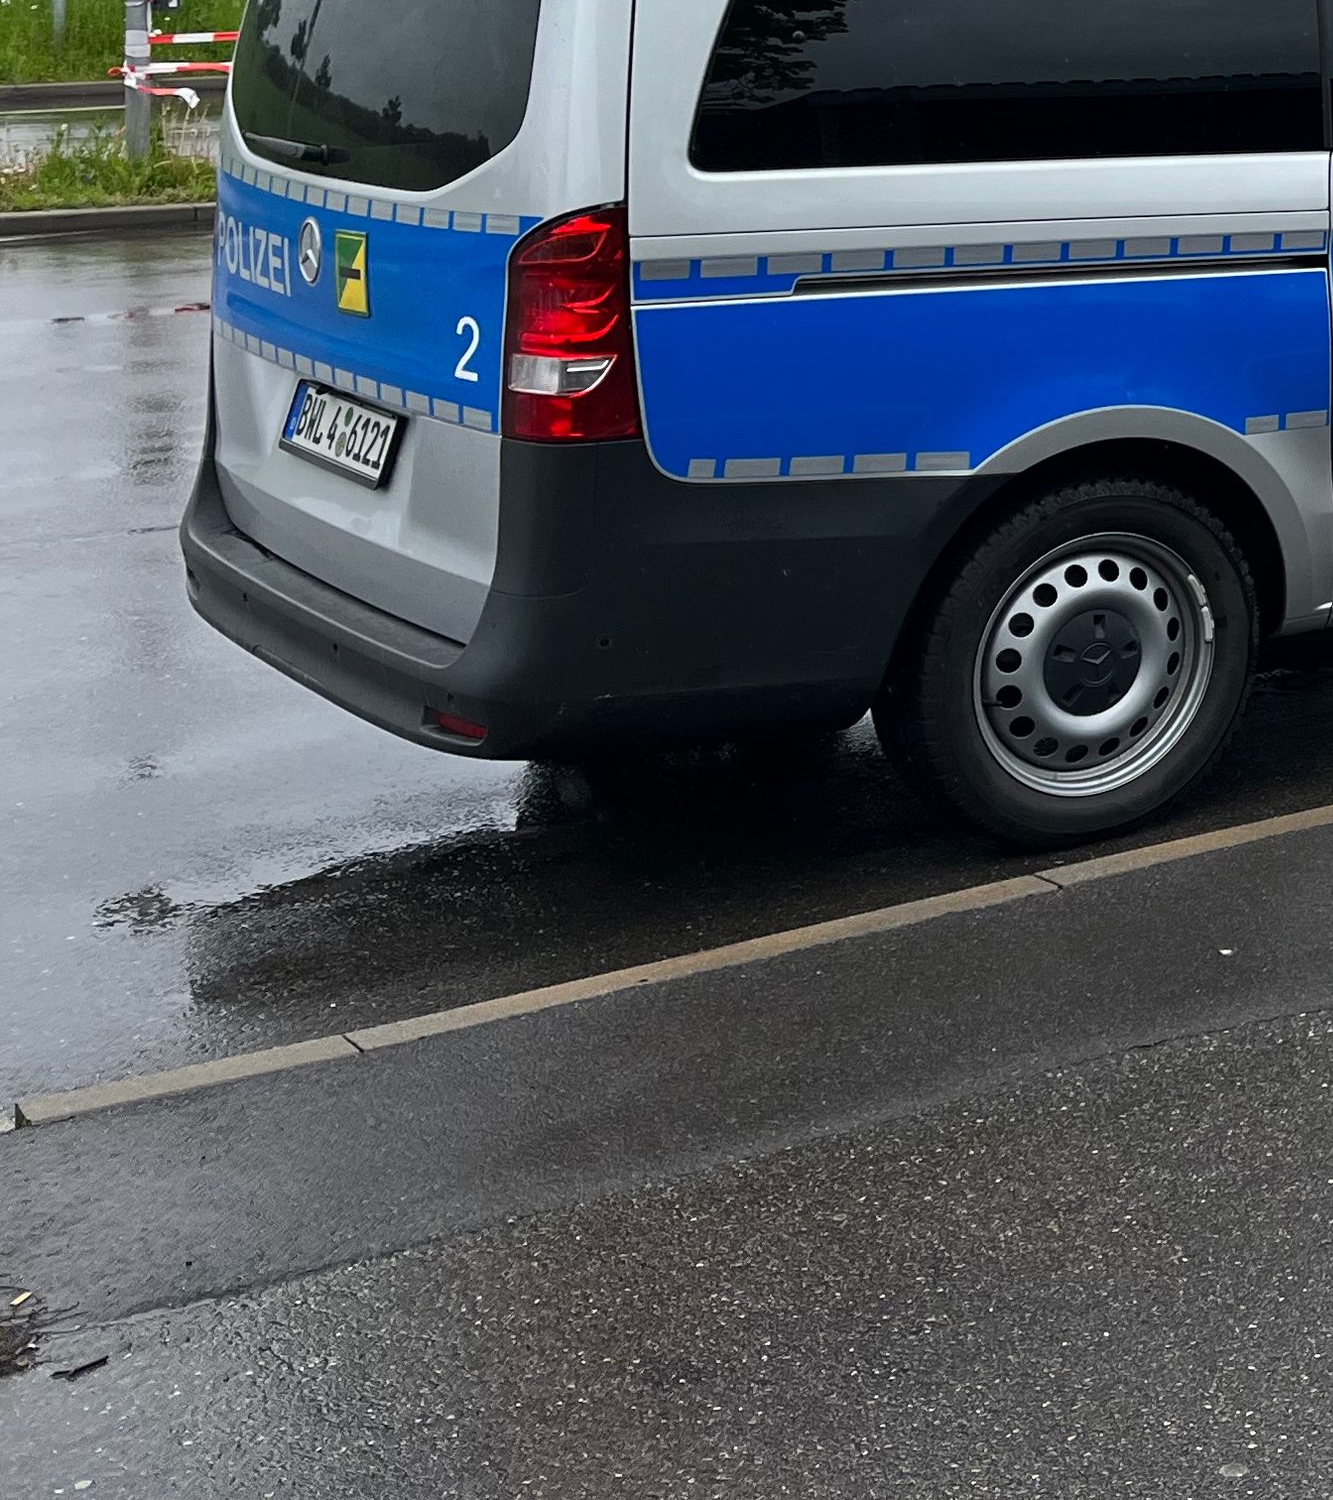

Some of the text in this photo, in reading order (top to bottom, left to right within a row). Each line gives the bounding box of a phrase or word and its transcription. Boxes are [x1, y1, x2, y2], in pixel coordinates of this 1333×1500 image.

[217, 211, 292, 298] POLIZEI
[454, 316, 481, 382] 2
[345, 414, 391, 470] 6121
